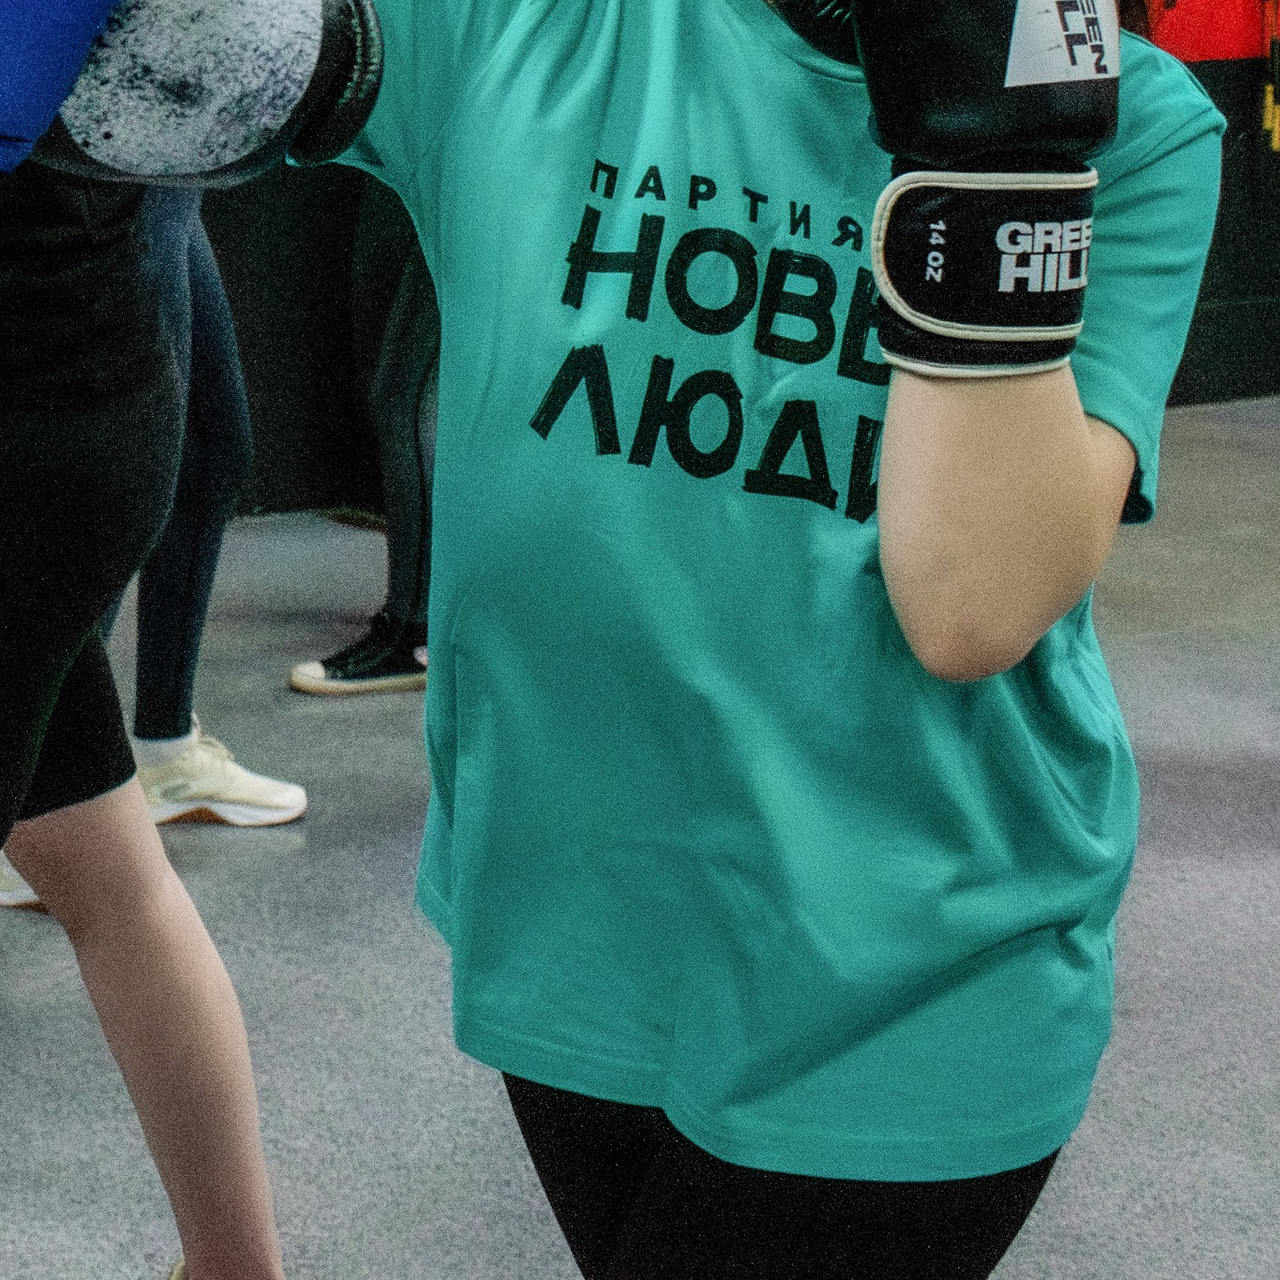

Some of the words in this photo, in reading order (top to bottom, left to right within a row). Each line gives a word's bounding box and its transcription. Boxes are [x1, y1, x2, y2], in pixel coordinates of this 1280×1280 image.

[588, 158, 865, 254] ПАРТИЯ
[927, 219, 948, 246] 14
[924, 250, 946, 284] OZ
